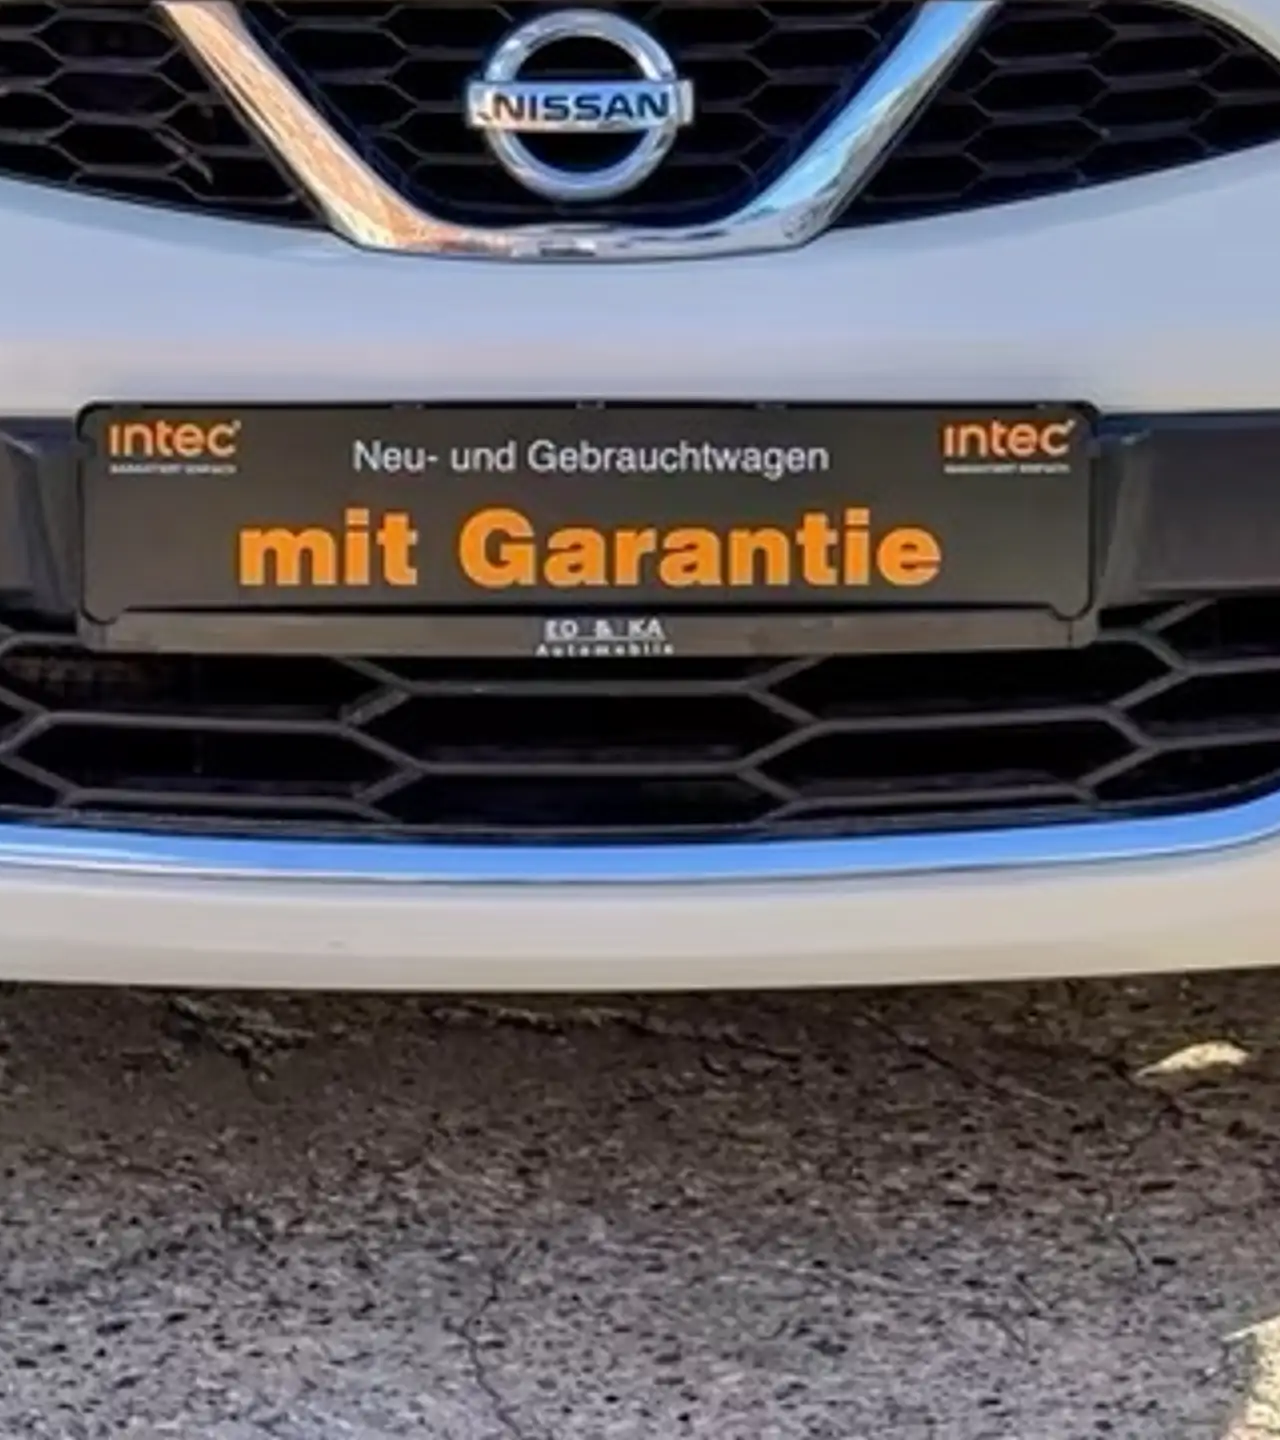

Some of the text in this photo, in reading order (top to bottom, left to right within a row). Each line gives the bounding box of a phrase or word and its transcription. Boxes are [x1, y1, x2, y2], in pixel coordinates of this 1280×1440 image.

[490, 92, 670, 121] NISSAN
[109, 420, 236, 457] intec
[943, 420, 1070, 457] intec
[353, 439, 829, 481] Neu- und Gebrauchtwagen
[238, 507, 942, 588] mit Garantie
[628, 617, 666, 641] KA
